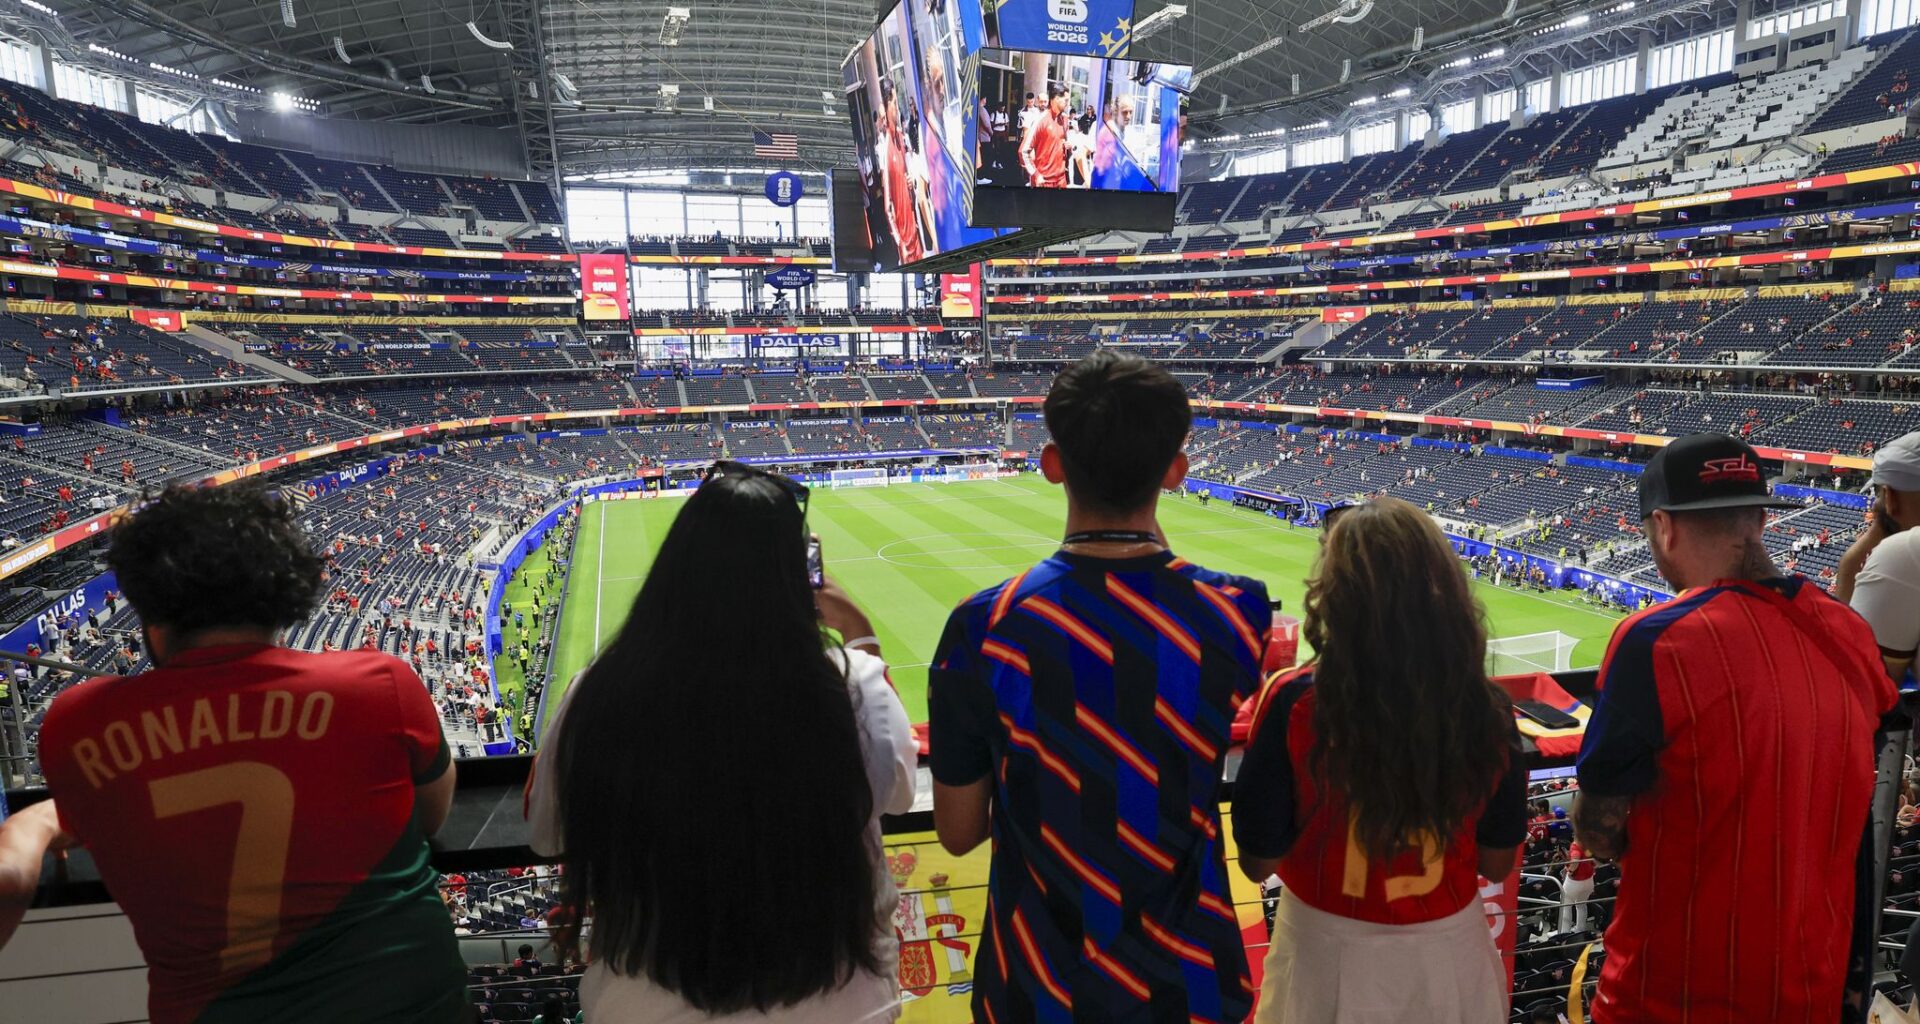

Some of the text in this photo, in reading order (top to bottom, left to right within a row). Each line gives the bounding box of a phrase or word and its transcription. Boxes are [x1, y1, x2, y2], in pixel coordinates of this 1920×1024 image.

[1059, 7, 1077, 16] FIFA
[1048, 22, 1088, 33] WORLD CUP
[1047, 30, 1088, 44] 2026
[224, 255, 249, 264] DALLAS
[760, 337, 836, 347] DALLAS
[731, 421, 770, 429] DALLAS
[339, 465, 368, 481] DALLAS
[37, 589, 85, 635] DALLAS
[72, 690, 334, 789] RONALDO
[147, 761, 295, 972] 7
